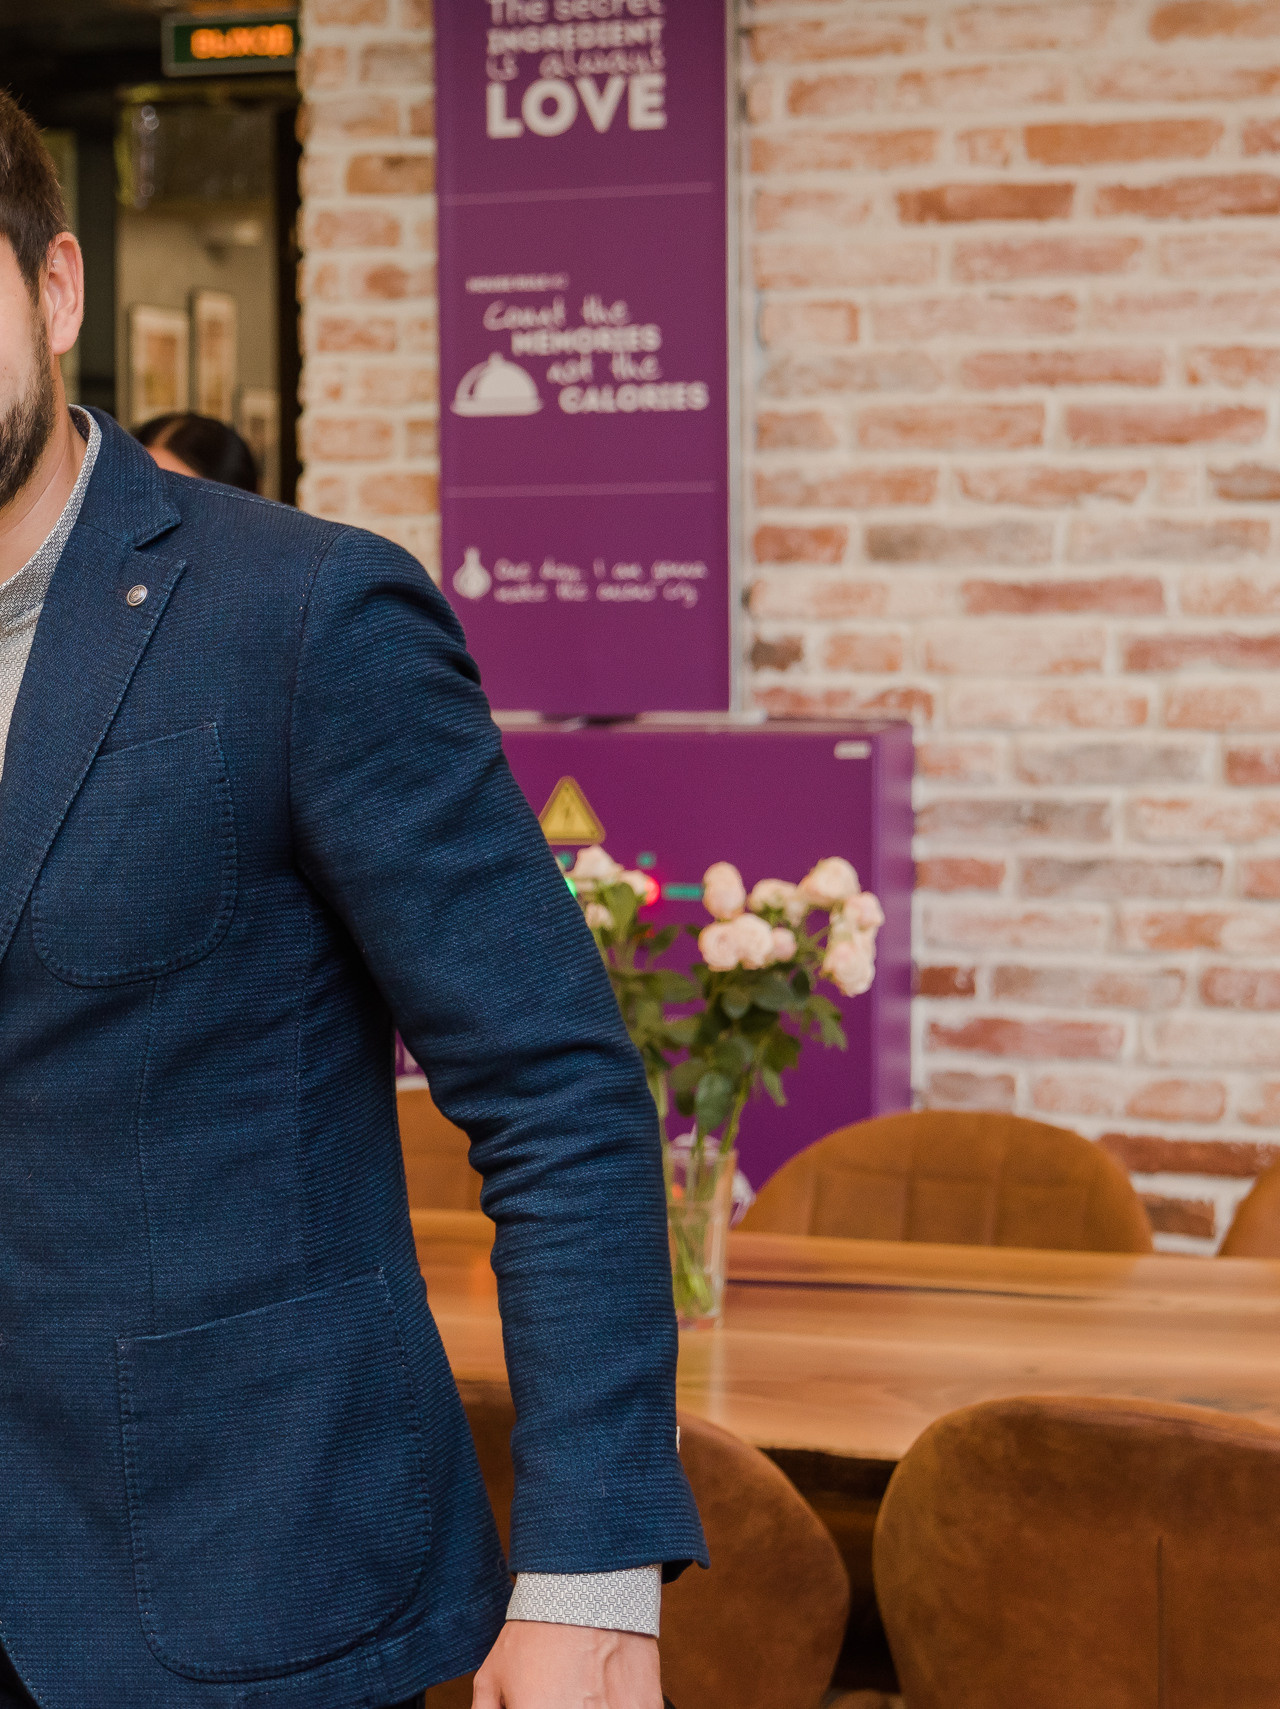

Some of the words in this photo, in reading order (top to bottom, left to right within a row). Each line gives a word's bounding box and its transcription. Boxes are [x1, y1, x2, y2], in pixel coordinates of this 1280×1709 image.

[489, 0, 549, 25] The
[554, 0, 664, 22] secret
[487, 18, 664, 55] INGREDIENT
[486, 73, 667, 139] LOVE
[483, 295, 566, 331] Count
[581, 294, 630, 326] the
[511, 324, 661, 356] MEMORIES
[547, 352, 594, 385] not
[611, 351, 662, 382] the
[558, 381, 709, 413] CALORIES
